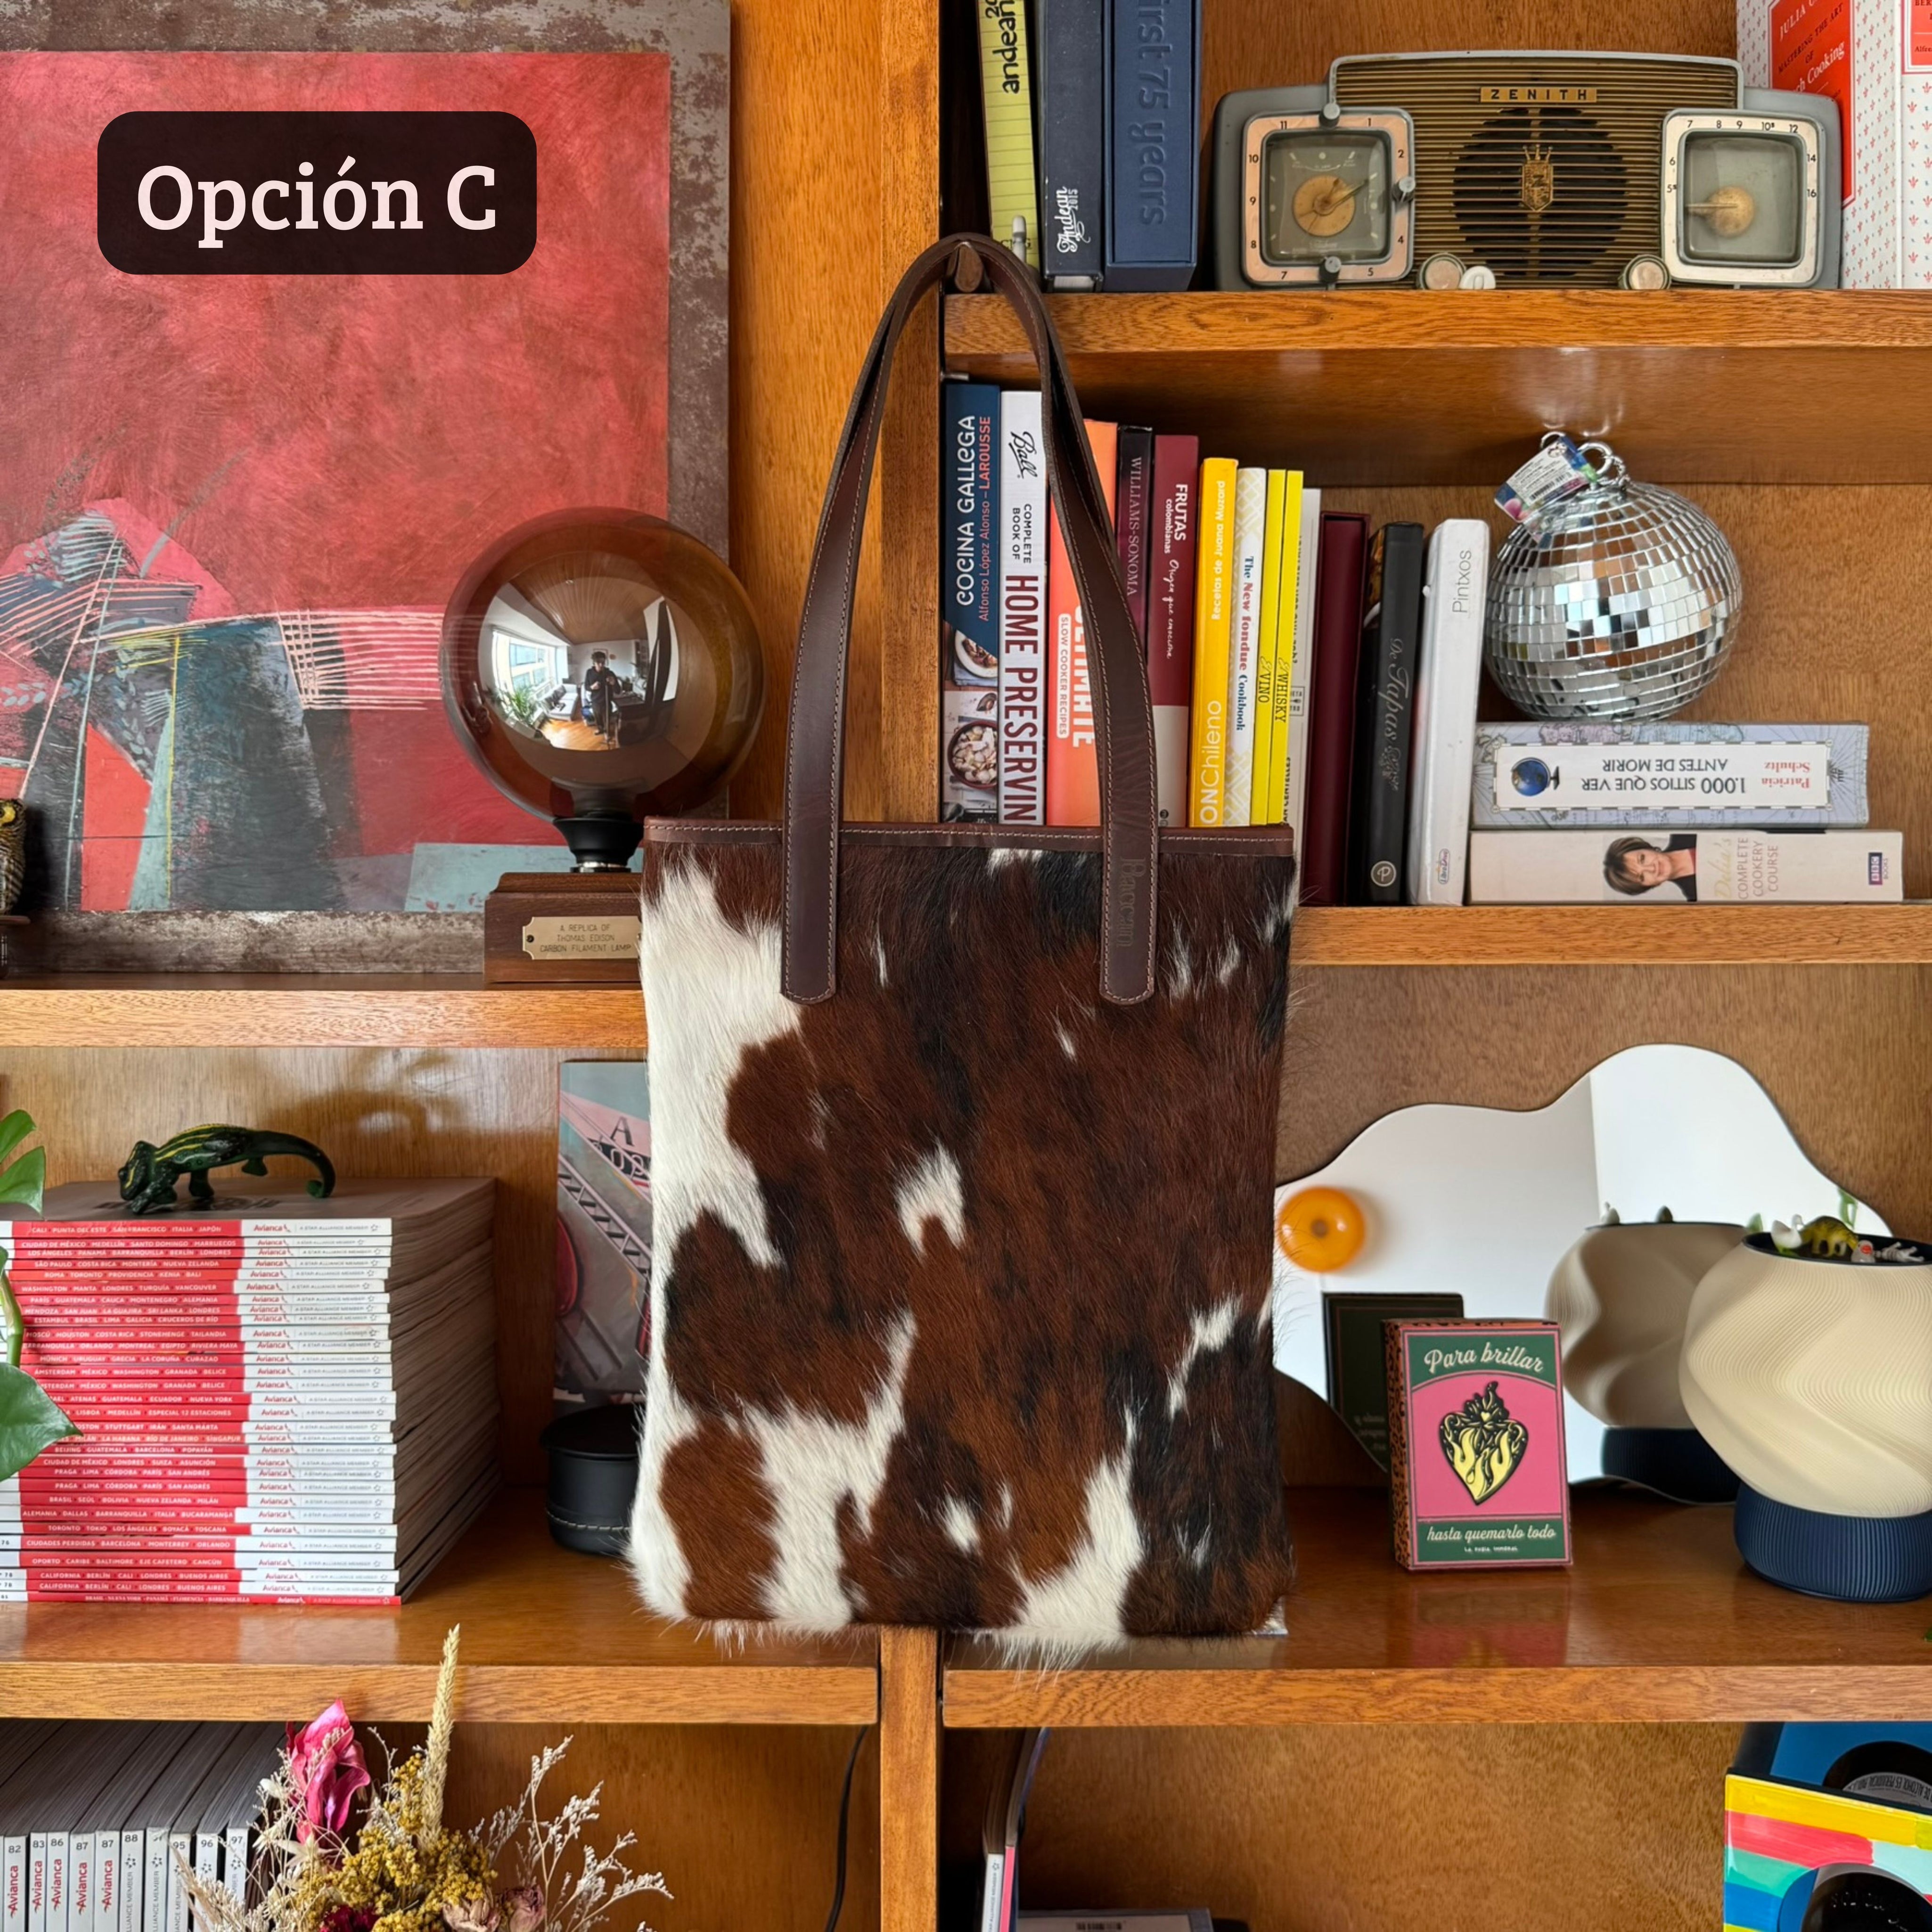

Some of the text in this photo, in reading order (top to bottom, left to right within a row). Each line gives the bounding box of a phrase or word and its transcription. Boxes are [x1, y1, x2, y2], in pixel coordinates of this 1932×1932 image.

[1778, 34, 1813, 74] MASTERING
[1815, 18, 1827, 36] THE
[1830, 3, 1843, 21] ART
[1780, 4, 1806, 42] JULIA
[992, 0, 1020, 94] andean
[1808, 41, 1845, 83] Cooking
[1138, 66, 1171, 109] 75
[1490, 89, 1587, 100] ZENITH
[1280, 118, 1371, 130] 11 1
[1716, 120, 1722, 129] 8
[1736, 121, 1743, 129] 9
[1789, 124, 1798, 133] 12
[1248, 154, 1259, 164] 10
[1398, 149, 1404, 158] 2
[1669, 157, 1676, 165] 6
[1807, 154, 1816, 163] 14
[1128, 121, 1166, 225] years
[1250, 196, 1256, 205] 9
[1807, 189, 1817, 197] 16
[1054, 186, 1091, 253] Andean
[1250, 240, 1257, 249] 8
[1397, 235, 1404, 244] 4
[1281, 271, 1287, 280] 7
[1367, 267, 1374, 277] 5
[1008, 431, 1038, 479] Ball
[956, 416, 975, 606] COCINA GALLEGA
[978, 417, 991, 621] Alfonso López Alonso LAROUSSE
[1127, 457, 1142, 596] WILLIAMS-SONOMA
[1164, 498, 1172, 554] colombianas
[1174, 484, 1187, 541] FRUTAS
[1013, 508, 1021, 560] BOOK OF
[1023, 504, 1032, 564] COMPLETE
[1212, 480, 1225, 620] Recetas de Juana Muzard
[1163, 559, 1179, 593] Origen
[1244, 556, 1254, 578] The
[1452, 549, 1472, 614] Pintxos
[1162, 596, 1173, 615] que
[1243, 582, 1253, 611] New
[1005, 575, 1039, 654] HOME
[1060, 649, 1068, 691] COOKER
[1236, 674, 1248, 731] Cookbook
[1258, 671, 1271, 703] VINO
[1275, 672, 1289, 723] WHISKY
[1378, 663, 1409, 741] Tapas
[1059, 694, 1068, 735] RECIPES
[1602, 759, 1727, 771] ANTES DE MORIR
[1765, 761, 1809, 772] Schultz
[1581, 775, 1745, 794] 1.000 SITIOS QUE VER
[1761, 778, 1809, 789] Patricia
[1708, 838, 1731, 900] Delia's
[1737, 837, 1749, 900] COMPLETE
[1752, 841, 1764, 897] COOKERY
[1768, 845, 1778, 892] COURSE
[1870, 855, 1880, 882] BBC
[1424, 1342, 1544, 1373] Para brillar
[1427, 1524, 1556, 1543] hasta quemarlo todo
[8, 1845, 21, 1853] 82
[33, 1840, 45, 1848] 83
[51, 1838, 64, 1846] 86
[76, 1842, 88, 1850] 87
[102, 1840, 114, 1848] 87
[124, 1834, 138, 1842] 88
[173, 1842, 186, 1850] 95
[201, 1839, 213, 1848] 96
[231, 1836, 243, 1844] 97
[8, 1865, 18, 1912] Avianca
[32, 1860, 42, 1908] Avianca
[51, 1858, 62, 1907] Avianca
[76, 1862, 88, 1909] Avianca
[101, 1859, 113, 1907] Avianca
